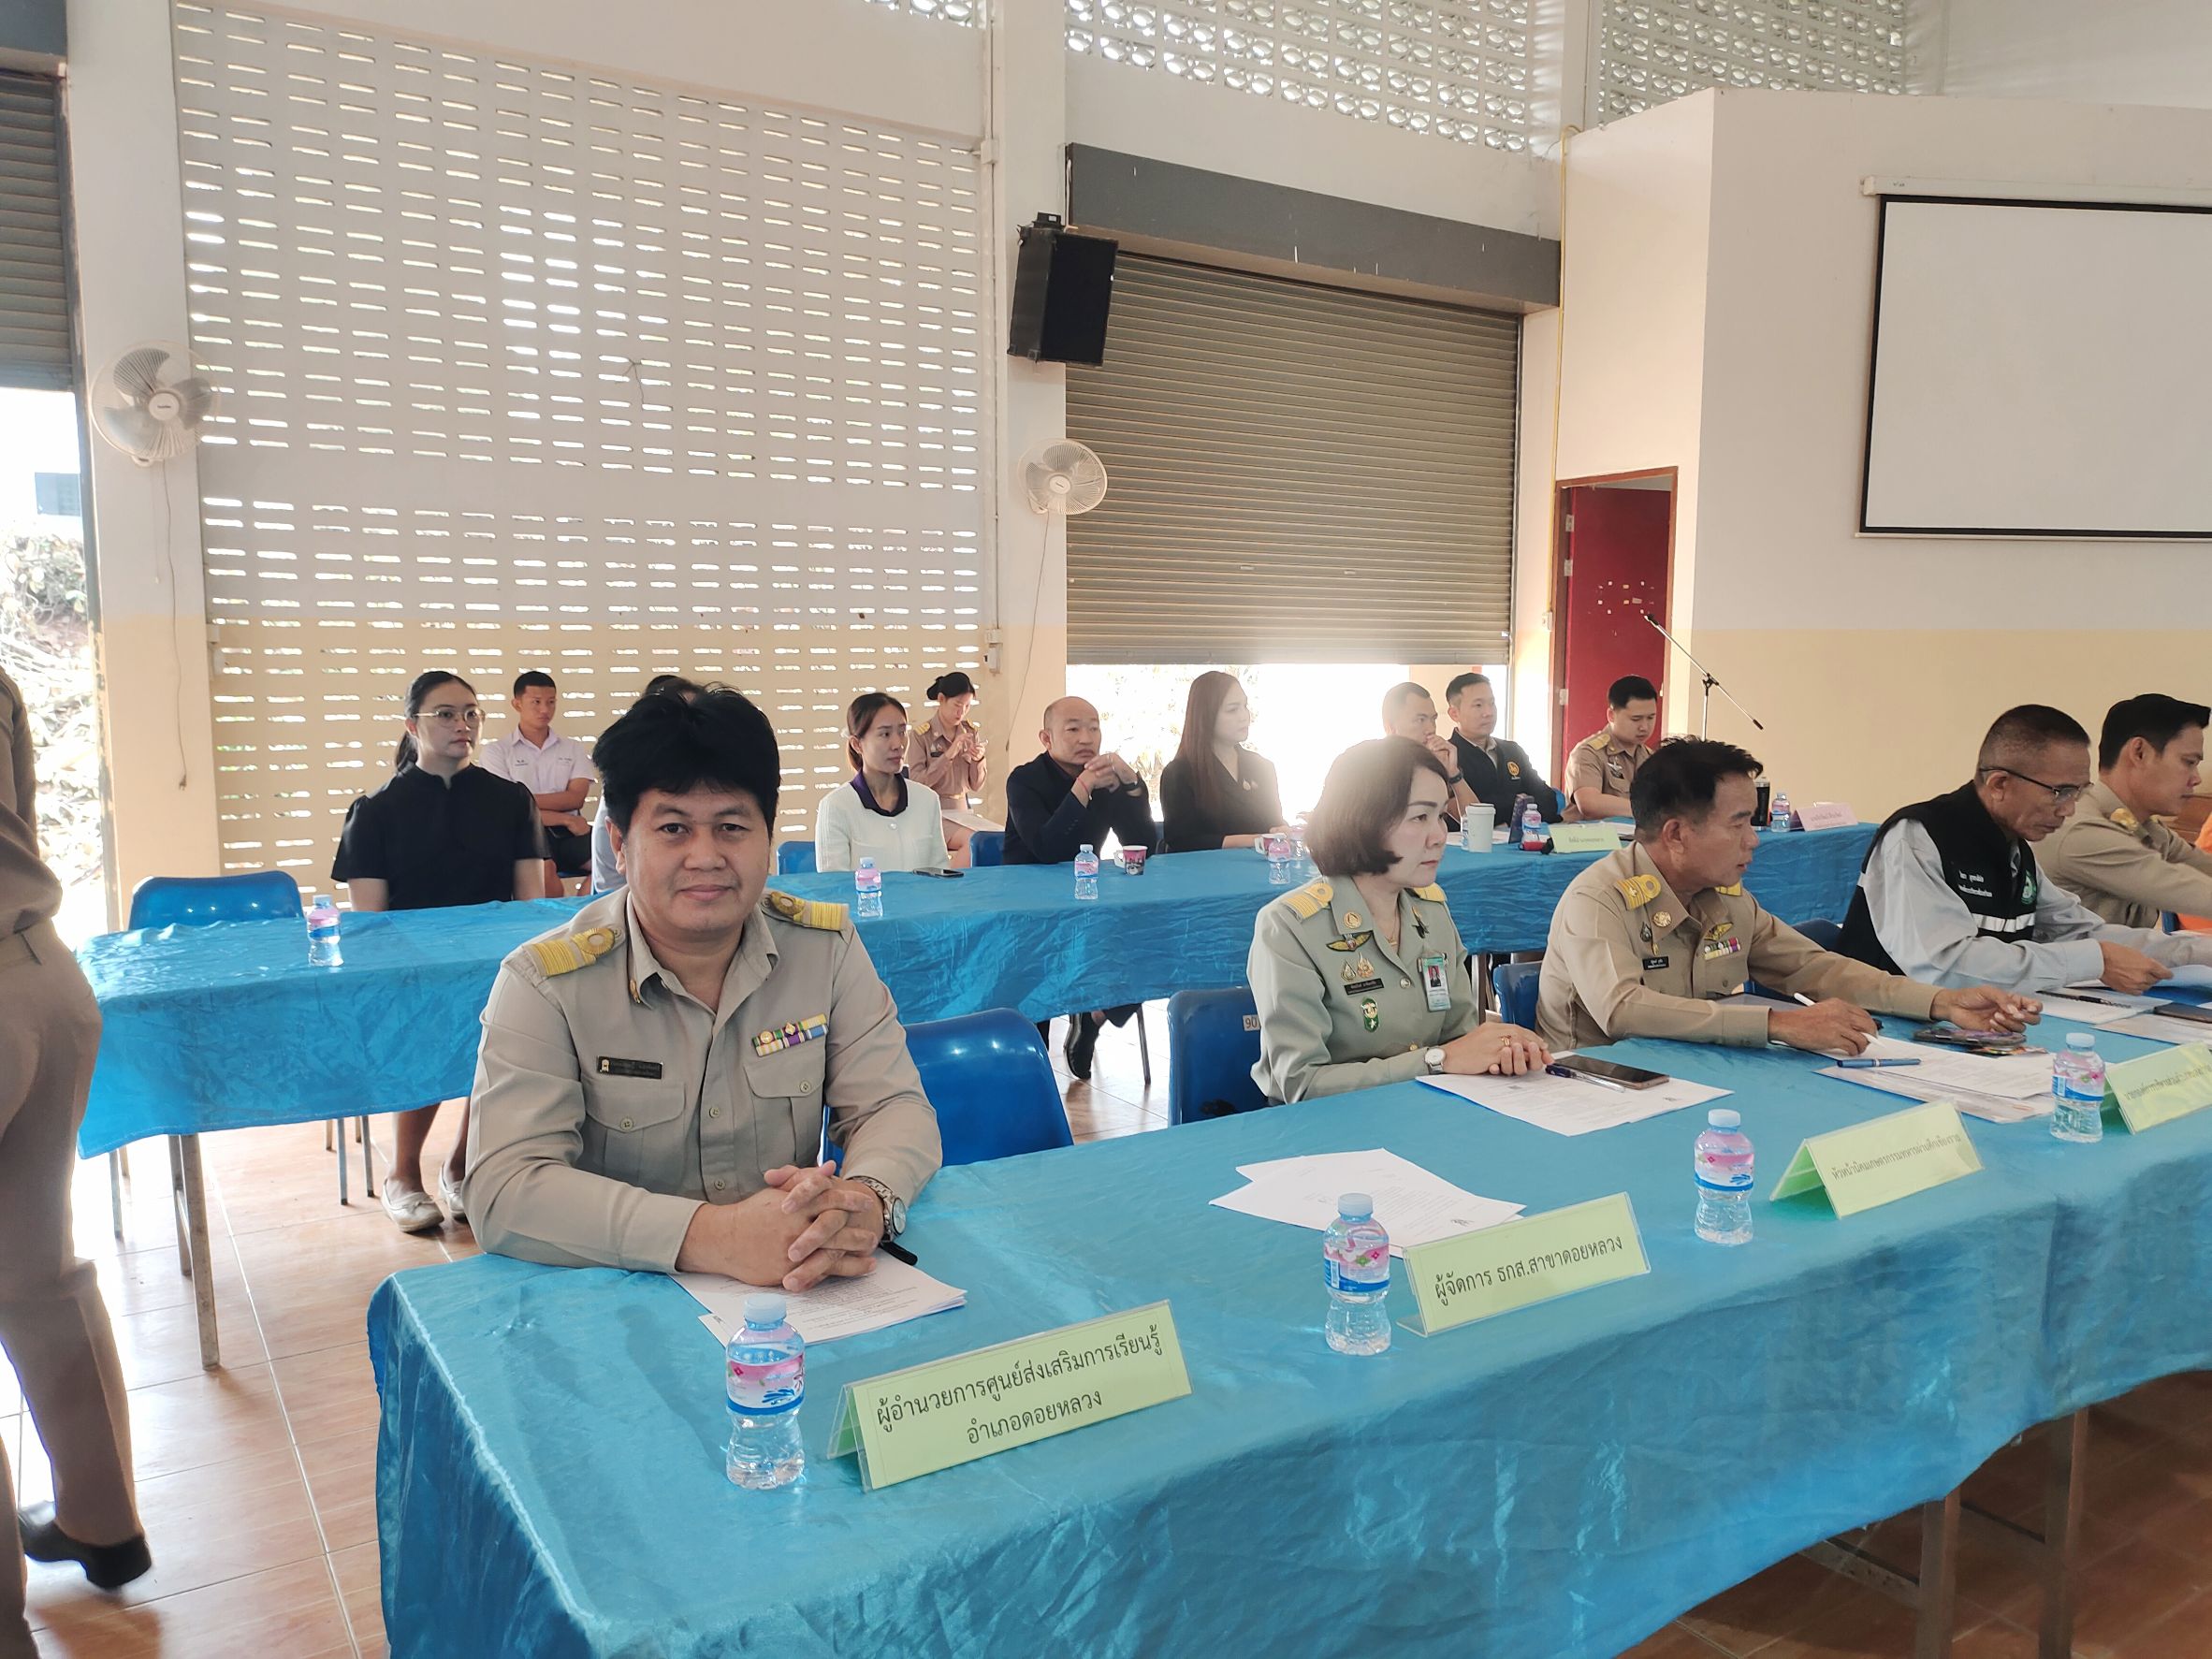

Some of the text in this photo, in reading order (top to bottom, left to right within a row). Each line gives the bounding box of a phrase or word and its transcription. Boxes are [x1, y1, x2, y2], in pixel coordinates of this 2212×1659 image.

[1434, 1236, 1623, 1306] ผู้จัดการ ธกส.สาขาดอยหลวง
[876, 1323, 1163, 1433] ผู้อำนวยการศูนย์ส่งเสริมการเรียนรู้
[967, 1389, 1103, 1445] อำเภอดอยหลวง
